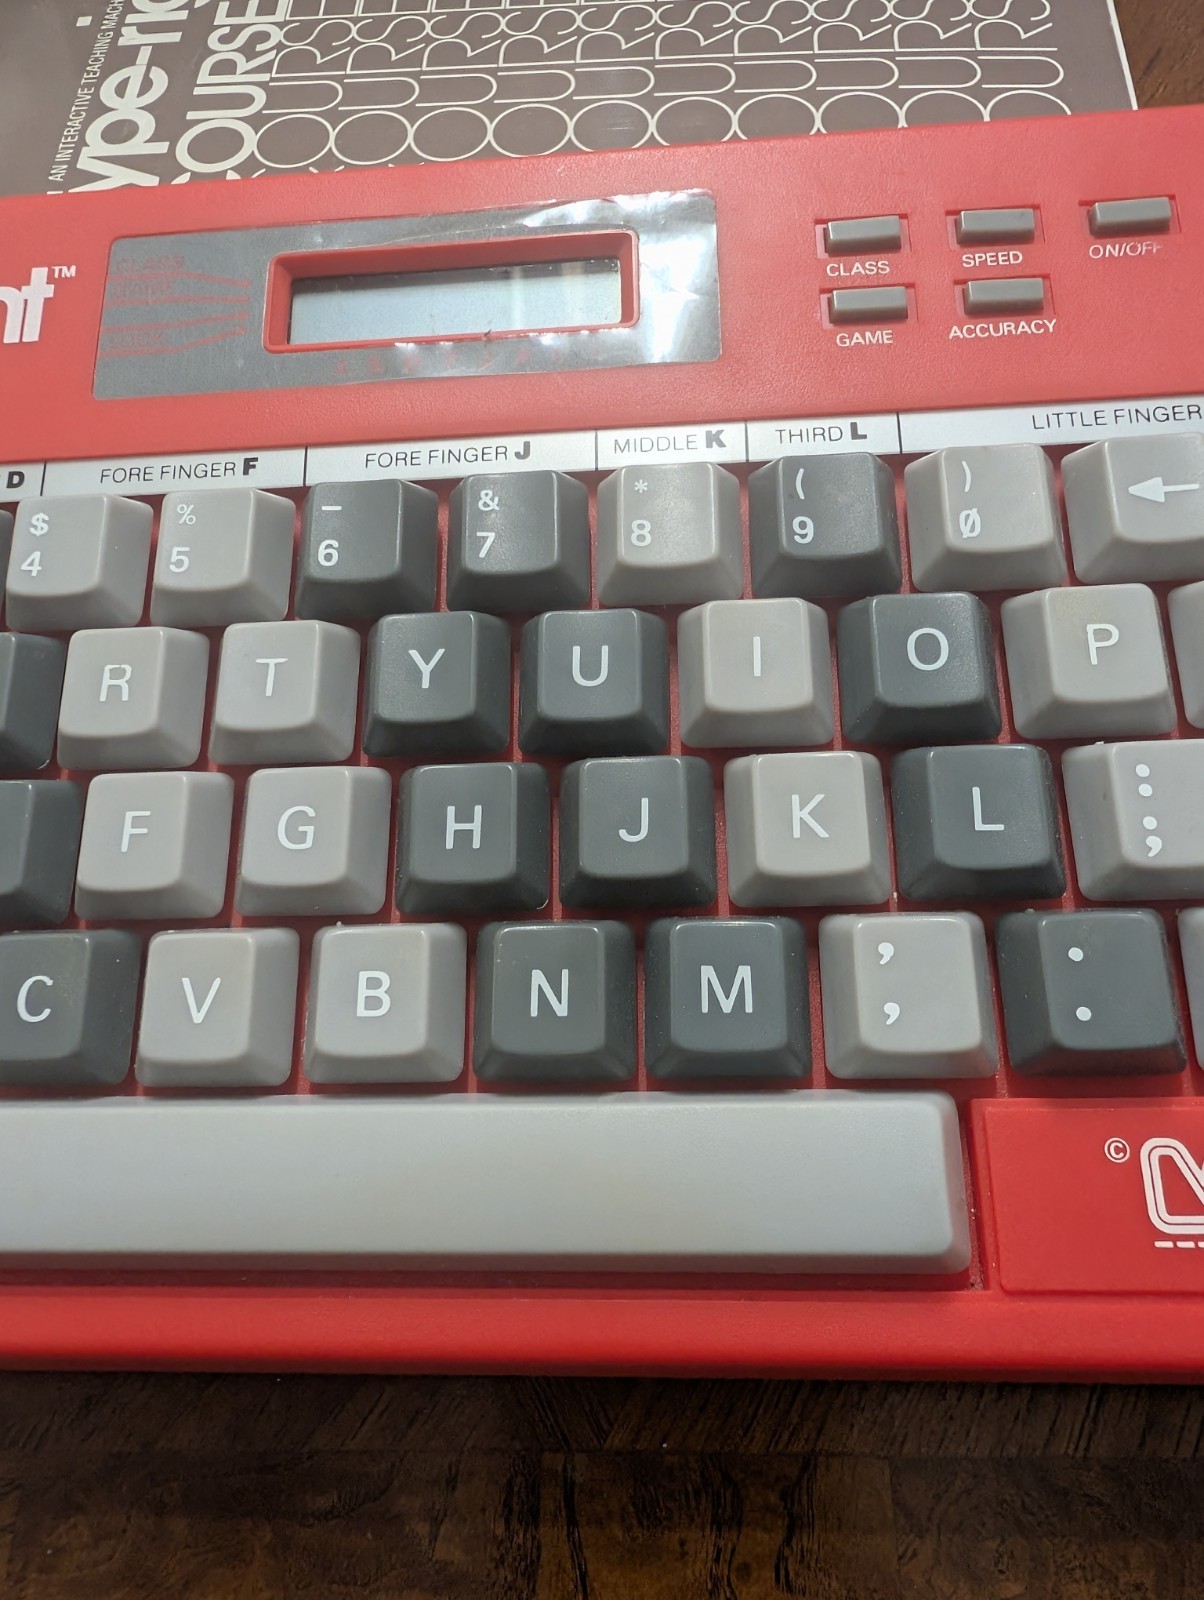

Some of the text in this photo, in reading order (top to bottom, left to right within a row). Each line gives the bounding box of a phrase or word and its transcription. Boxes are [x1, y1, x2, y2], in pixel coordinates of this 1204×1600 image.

[100, 0, 125, 30] MACH
[80, 31, 114, 85] TEACHING
[68, 0, 211, 193] ype-ri
[171, 0, 287, 184] OURSE
[252, 0, 357, 177] OURSE
[54, 86, 95, 164] INTERACTIVE
[48, 164, 68, 182] AN
[826, 260, 890, 277] CLASS
[961, 250, 1023, 268] SPEED
[835, 329, 894, 347] GAME
[948, 318, 1057, 340] ACCURACY
[775, 421, 868, 445] THIRD L
[1032, 404, 1203, 430] LITTLE FINGER
[365, 440, 531, 469] FORE FINGER J
[614, 429, 727, 454] MIDDLE K
[6, 470, 25, 489] D
[100, 457, 259, 483] FORE FINGER F
[176, 503, 196, 525] %
[477, 489, 501, 512] &
[29, 512, 50, 537] $
[630, 519, 652, 547] 8
[792, 515, 814, 544] 9
[169, 546, 190, 573] 5
[317, 539, 339, 567] 6
[476, 529, 501, 558] 7
[20, 550, 42, 577] 4
[752, 636, 761, 677] I
[906, 628, 949, 671] O
[1086, 623, 1120, 665] P
[100, 665, 131, 701] R
[256, 658, 288, 696] T
[409, 649, 445, 688] Y
[572, 645, 609, 686] U
[277, 806, 316, 849] G
[445, 804, 482, 850] H
[618, 797, 649, 842] J
[791, 794, 829, 839] K
[972, 787, 1005, 831] L
[120, 811, 151, 852] F
[16, 975, 54, 1023] C
[181, 977, 222, 1024] V
[356, 970, 391, 1017] B
[530, 968, 569, 1018] N
[700, 965, 753, 1014] M
